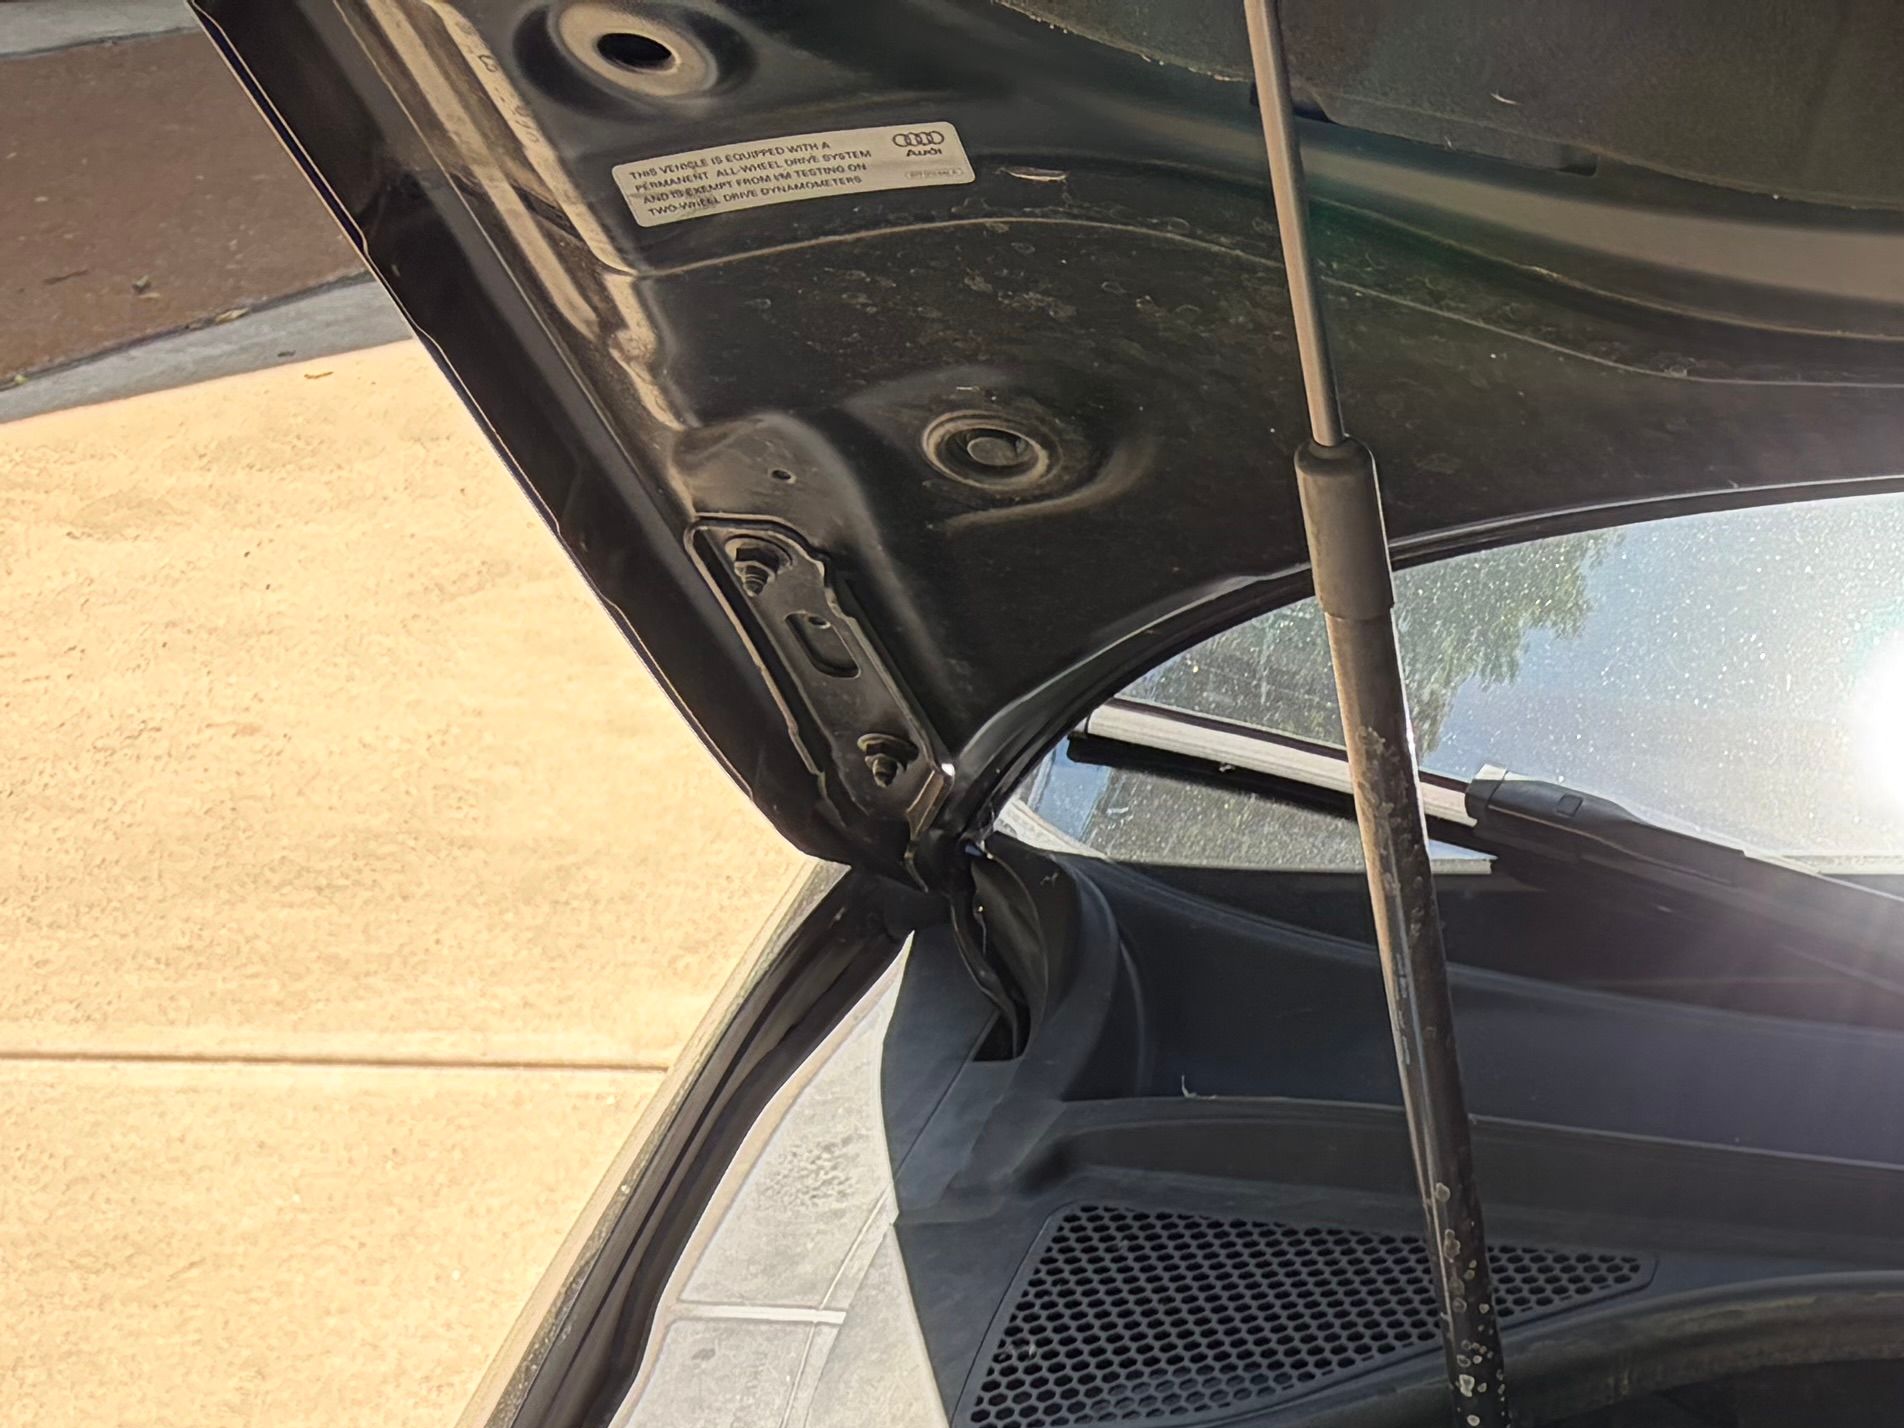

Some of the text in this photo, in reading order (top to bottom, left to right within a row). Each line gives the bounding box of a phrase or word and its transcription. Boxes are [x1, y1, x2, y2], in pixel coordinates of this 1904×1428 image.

[724, 146, 784, 162] EQUIPPED
[787, 142, 819, 153] WITH
[821, 141, 830, 149] A
[905, 147, 942, 157] Audi
[634, 171, 708, 191] PERMANENT
[783, 154, 819, 167] DRIVE
[822, 149, 871, 162] SYSTEM
[643, 192, 669, 204] AND
[684, 180, 732, 197] EXEMPT
[735, 174, 771, 186] FROM
[794, 164, 845, 177] TESTING
[847, 162, 867, 172] ON
[722, 189, 758, 202] DRIVE
[760, 175, 861, 195] DYNAMOMETERS
